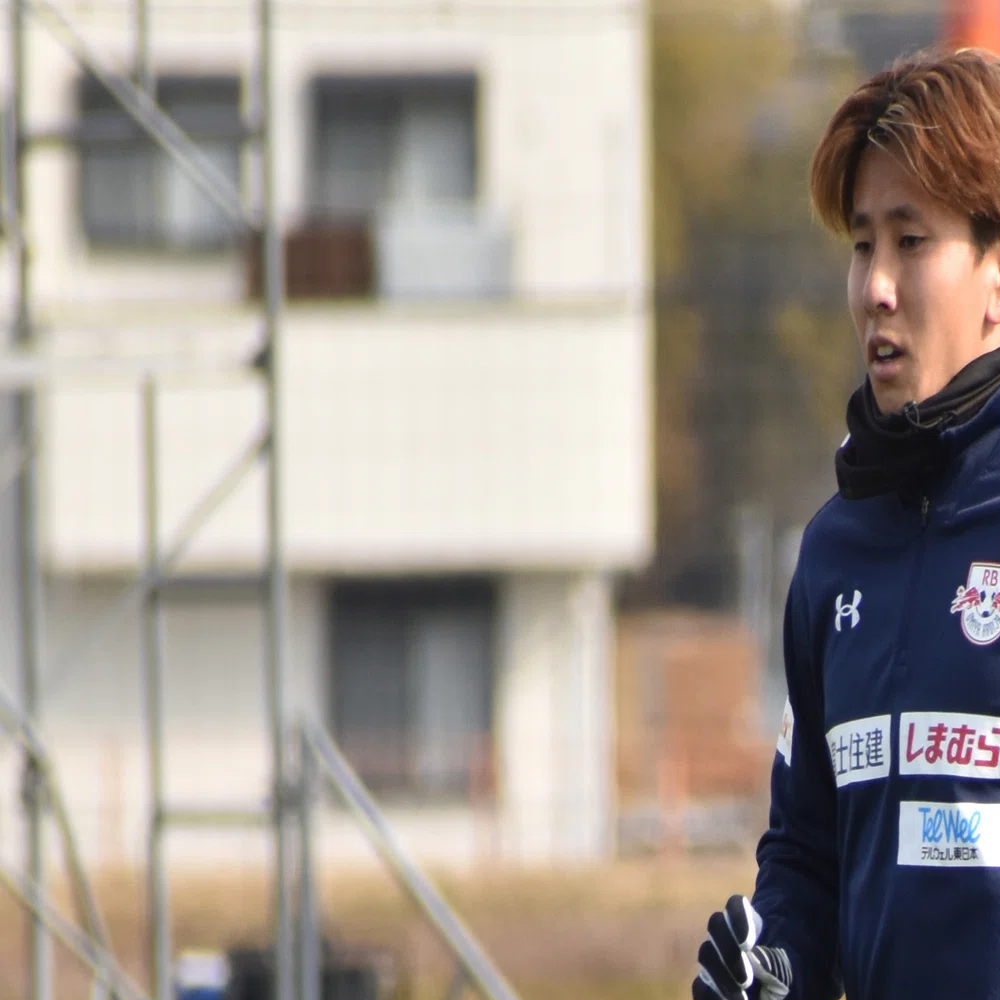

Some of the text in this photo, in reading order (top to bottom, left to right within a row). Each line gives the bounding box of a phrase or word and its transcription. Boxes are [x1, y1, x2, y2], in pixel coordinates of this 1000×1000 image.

[982, 569, 999, 587] RB
[920, 845, 980, 862] テルウェル東日本
